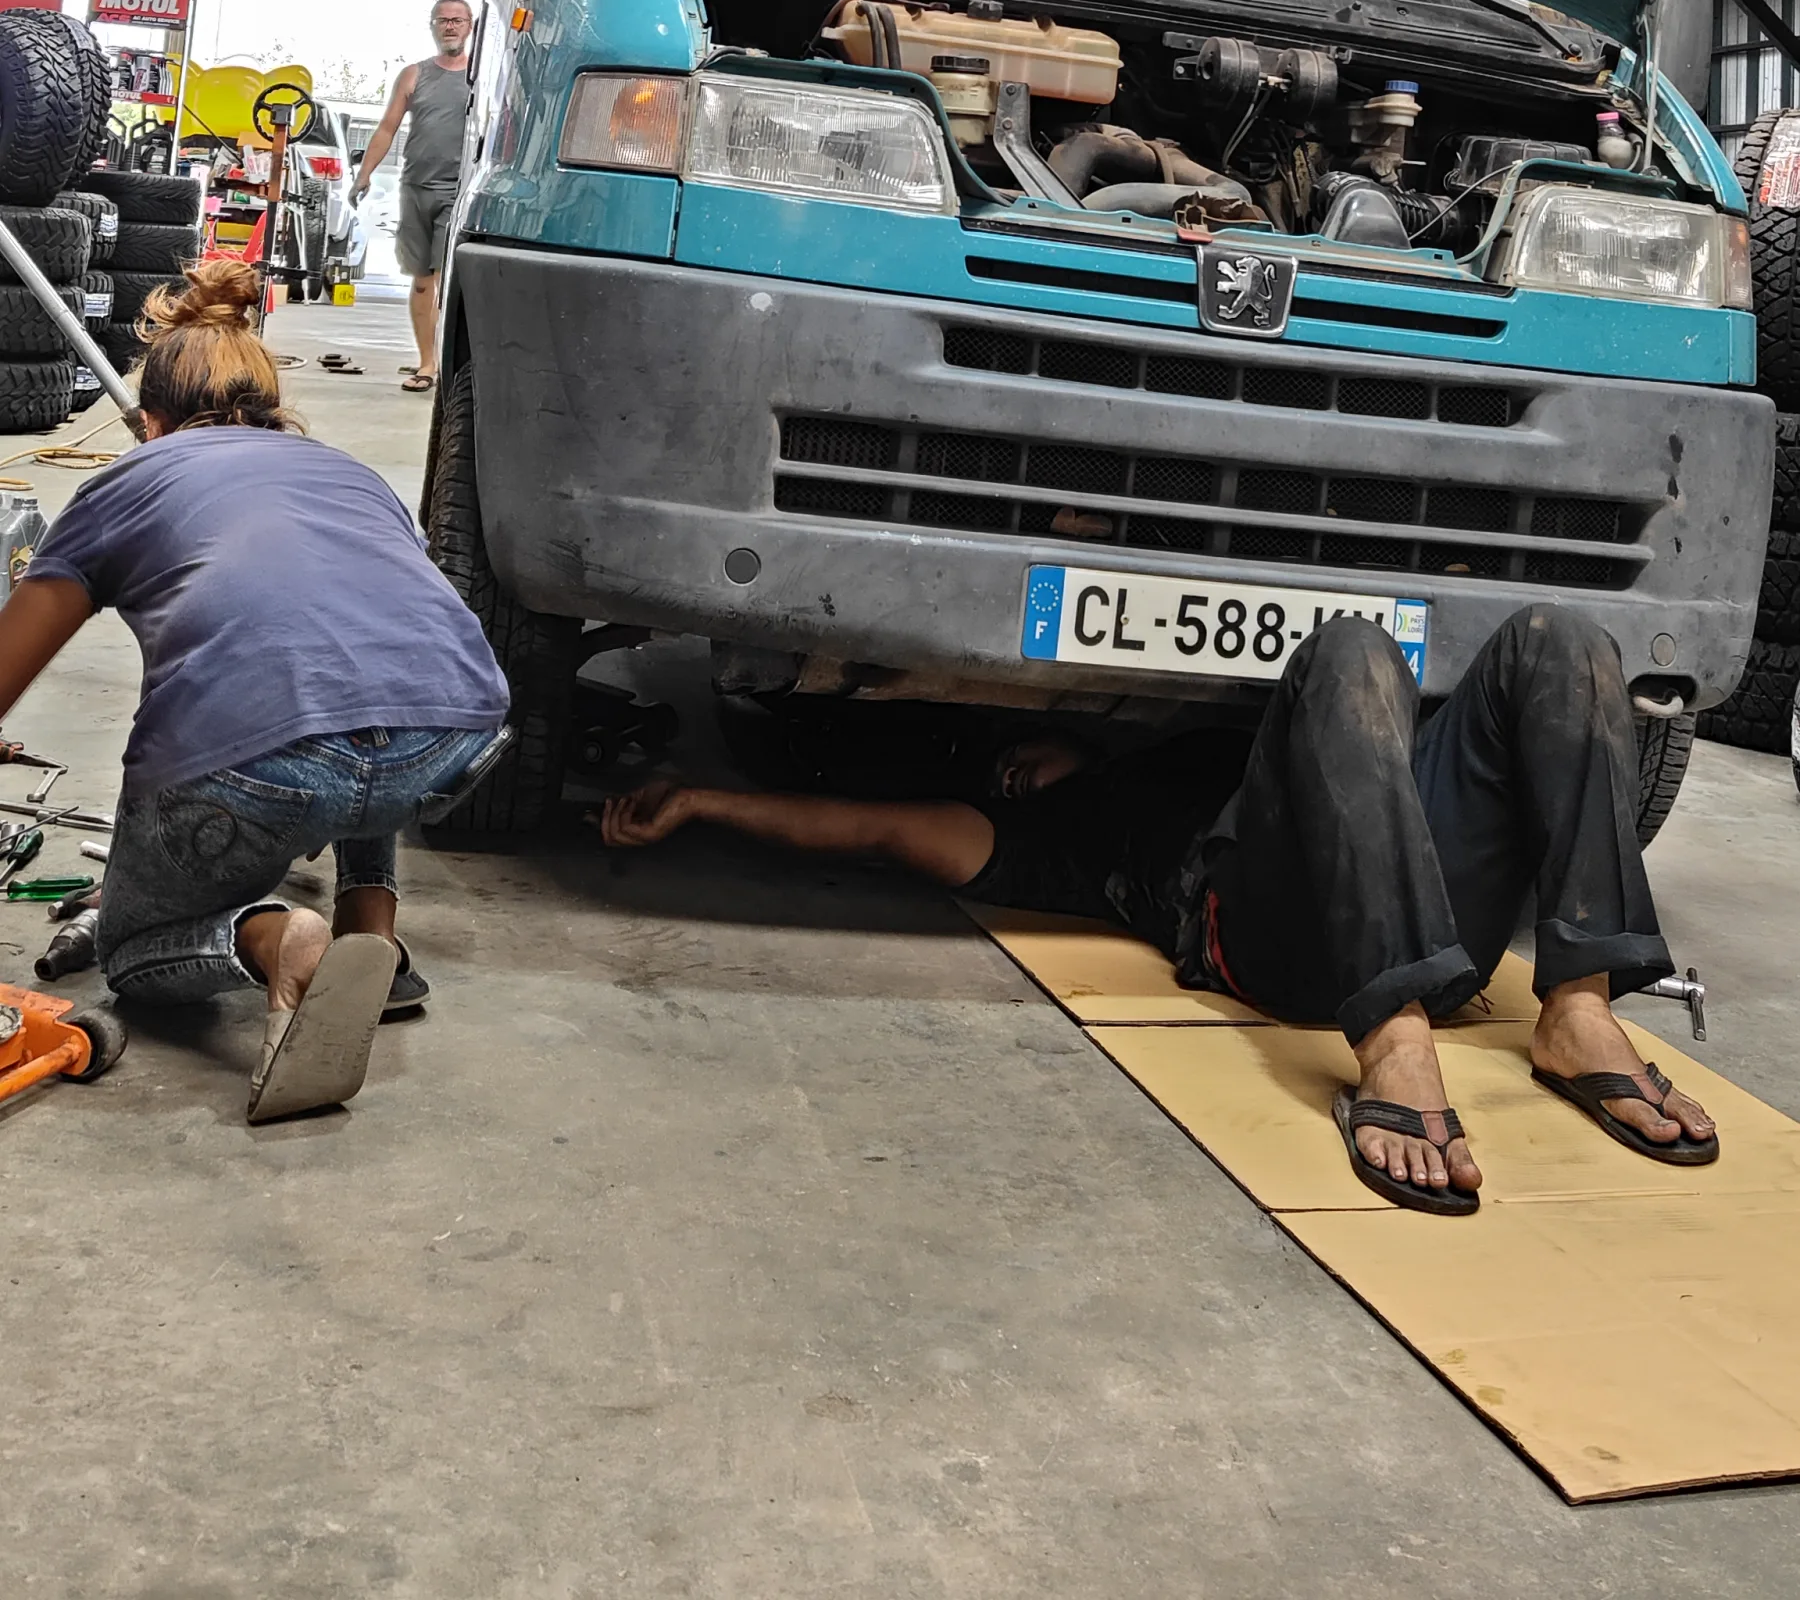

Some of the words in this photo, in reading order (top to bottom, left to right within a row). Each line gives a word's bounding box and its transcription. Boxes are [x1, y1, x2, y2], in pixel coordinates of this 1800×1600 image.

[111, 89, 142, 100] MOTUL
[1034, 620, 1048, 640] F
[1074, 585, 1384, 662] CL-588-
